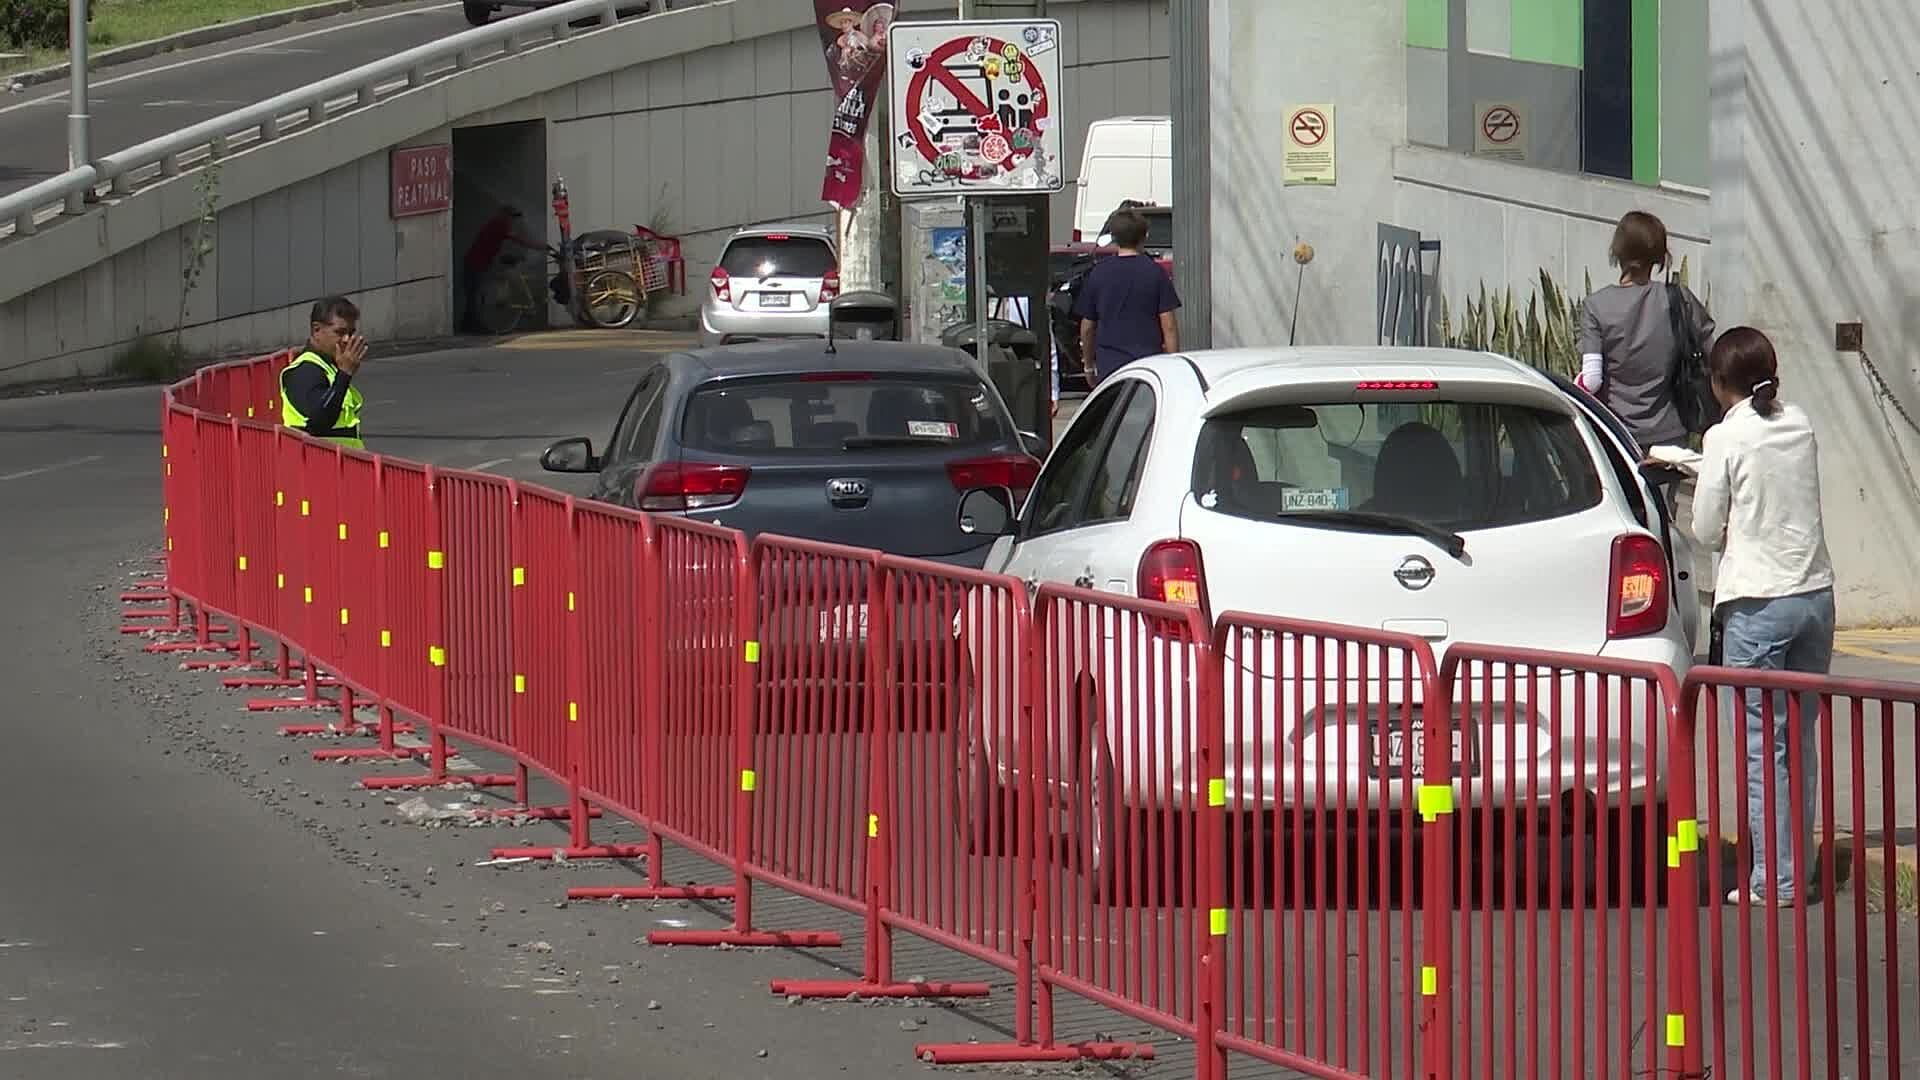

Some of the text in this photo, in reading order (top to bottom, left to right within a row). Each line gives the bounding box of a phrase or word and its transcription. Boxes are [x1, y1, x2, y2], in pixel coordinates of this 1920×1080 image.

[410, 156, 437, 178] PASO
[398, 183, 448, 207] PEATONAL
[838, 481, 861, 494] KIA
